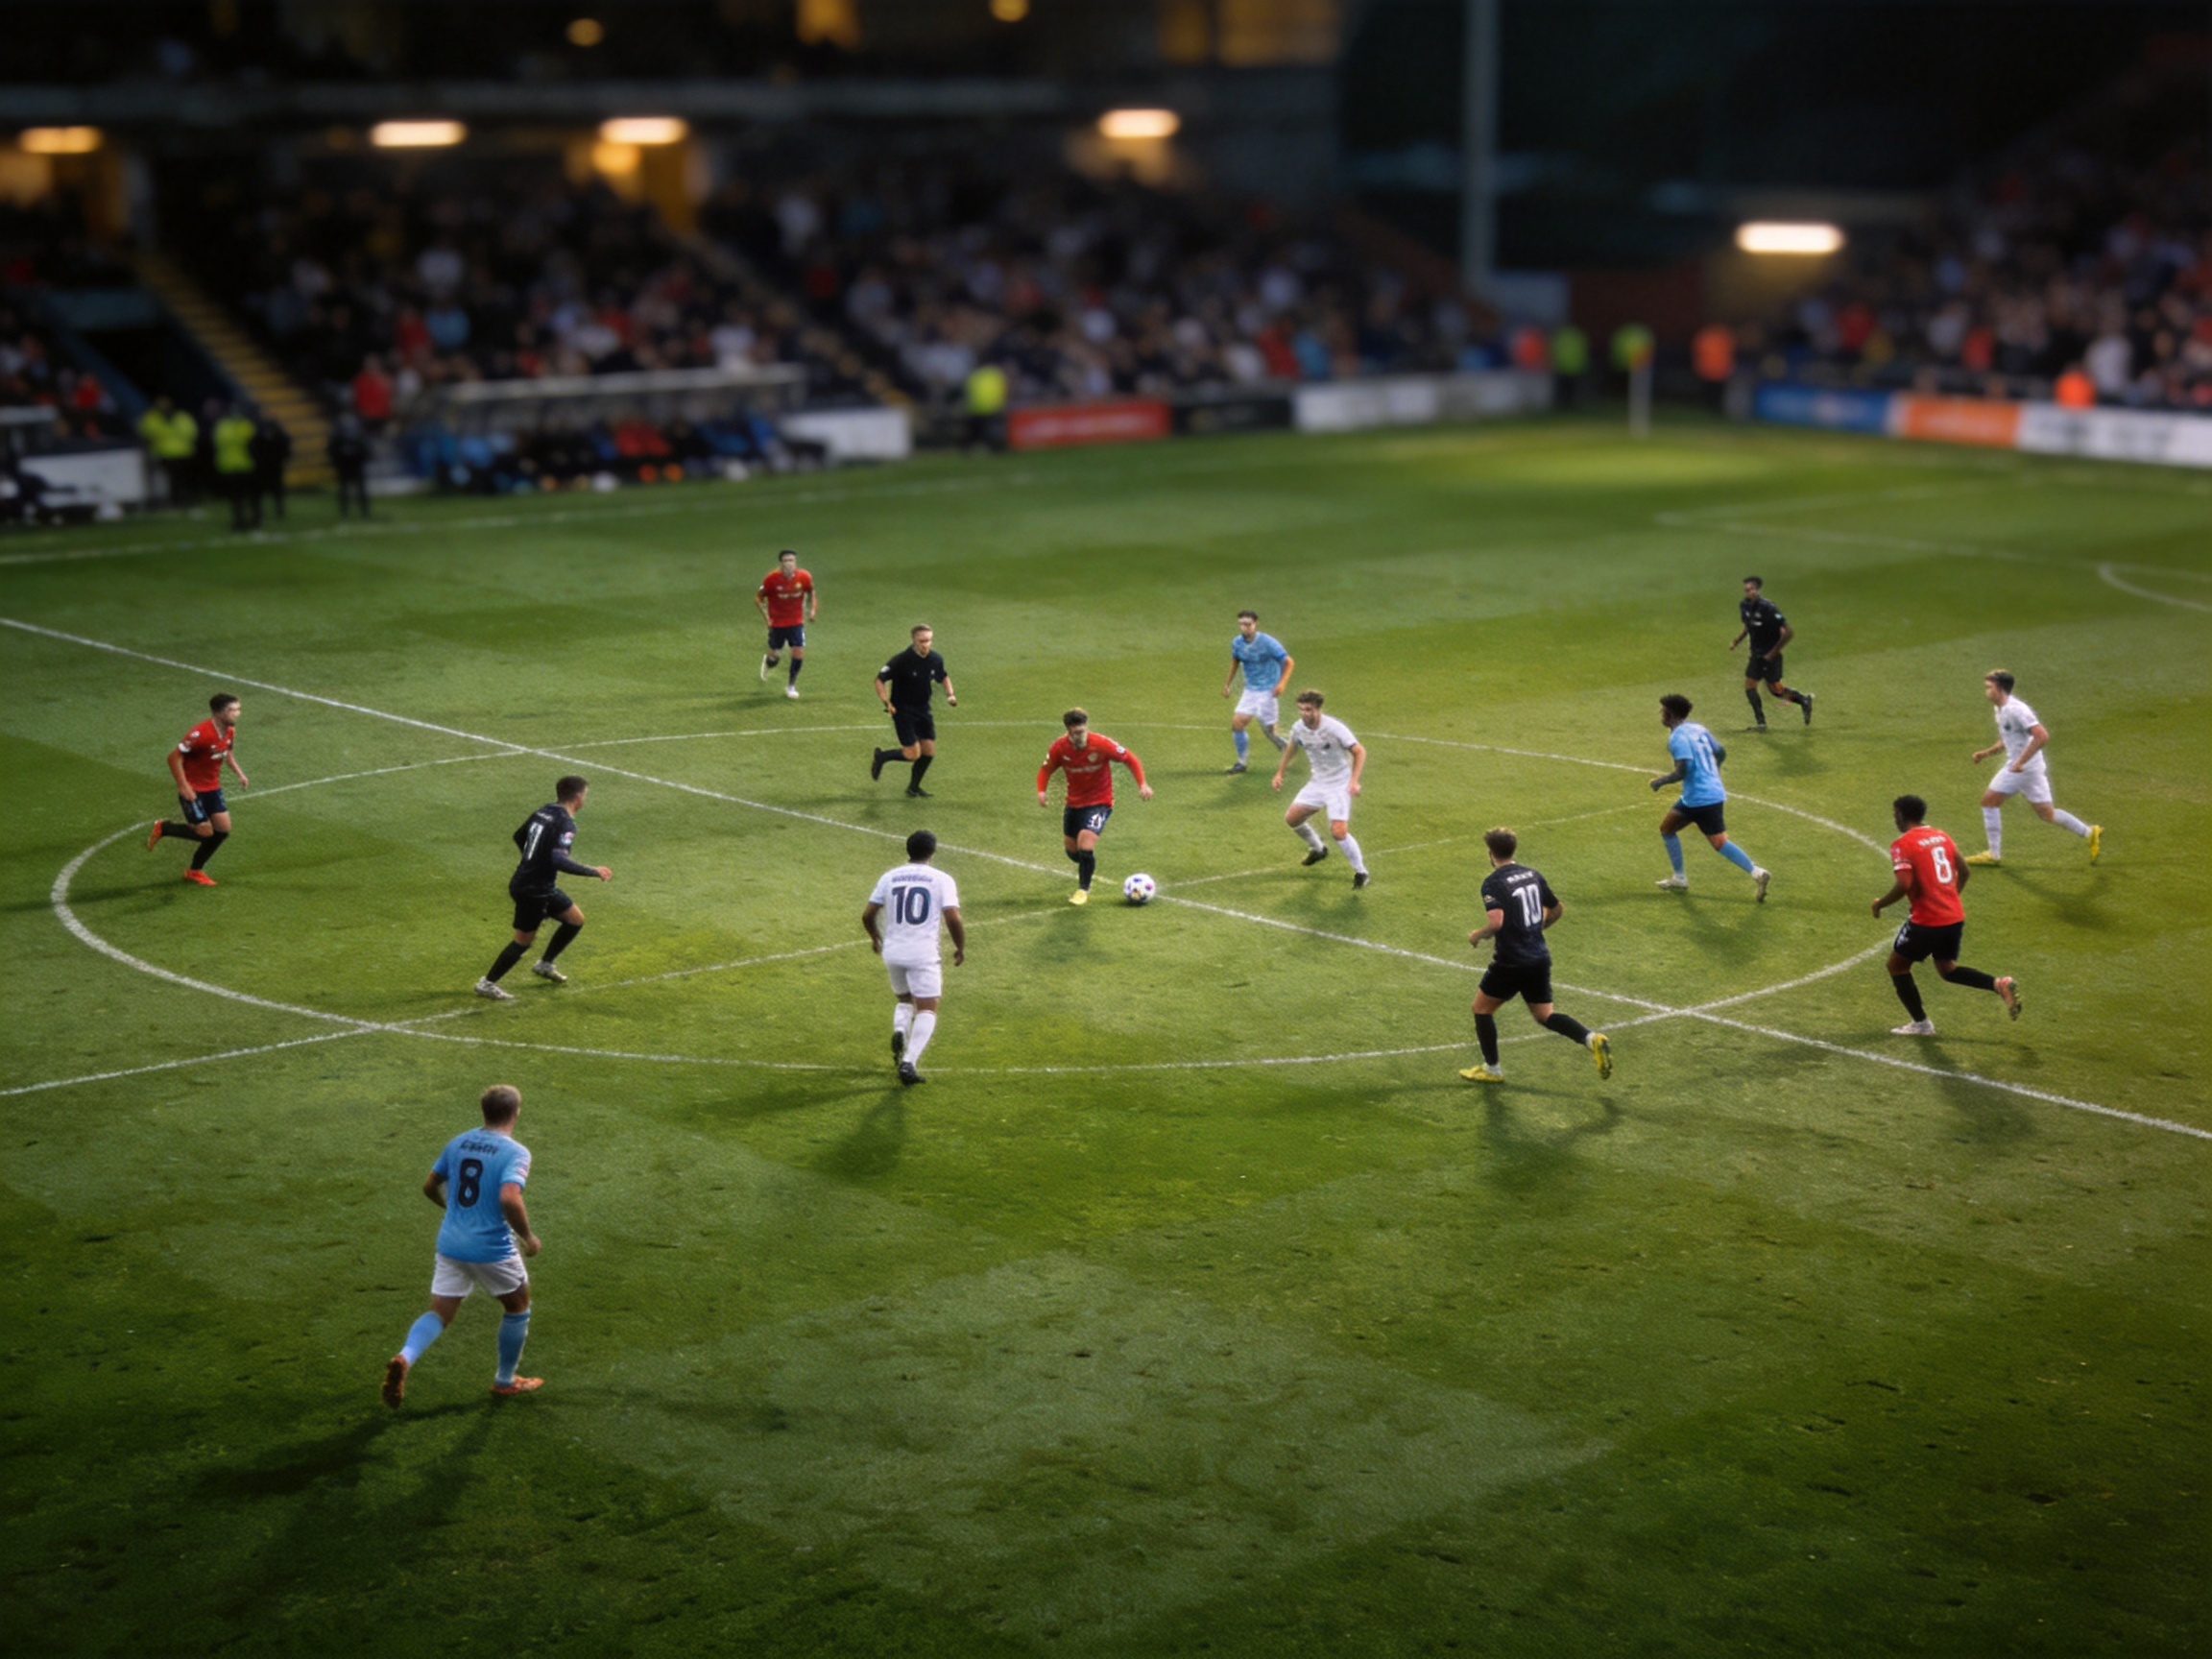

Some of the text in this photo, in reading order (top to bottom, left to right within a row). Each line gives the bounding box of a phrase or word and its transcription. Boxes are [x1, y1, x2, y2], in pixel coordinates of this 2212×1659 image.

[1931, 846, 1953, 884] 8
[892, 886, 931, 926] 10
[1511, 883, 1542, 927] 10
[458, 1158, 483, 1209] 8
